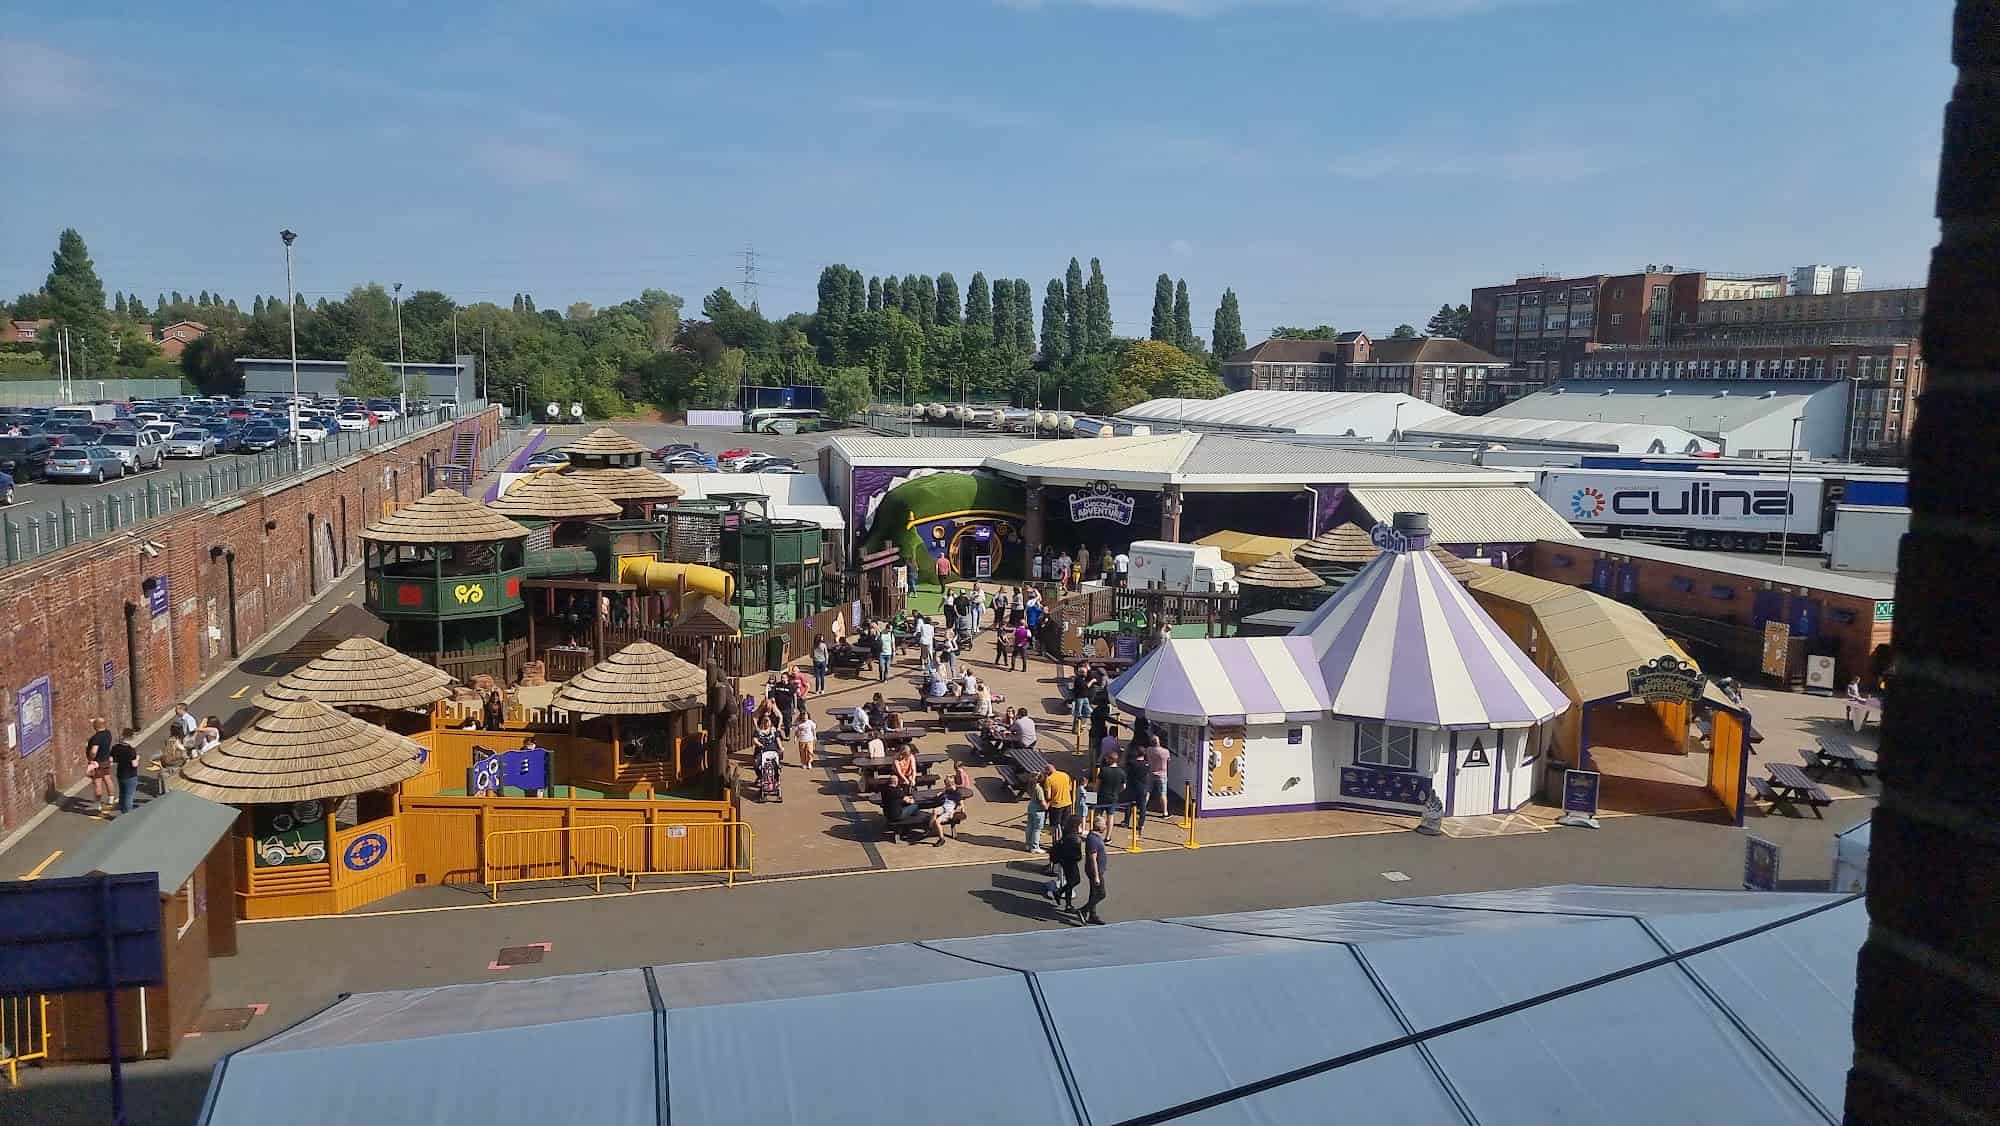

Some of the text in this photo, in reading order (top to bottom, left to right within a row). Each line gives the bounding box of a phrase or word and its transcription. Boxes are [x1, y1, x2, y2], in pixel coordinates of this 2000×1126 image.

[1095, 483, 1107, 491] 4D
[1612, 482, 1794, 515] culina
[1078, 507, 1125, 519] ADVENTURE
[1371, 522, 1407, 553] Cabin
